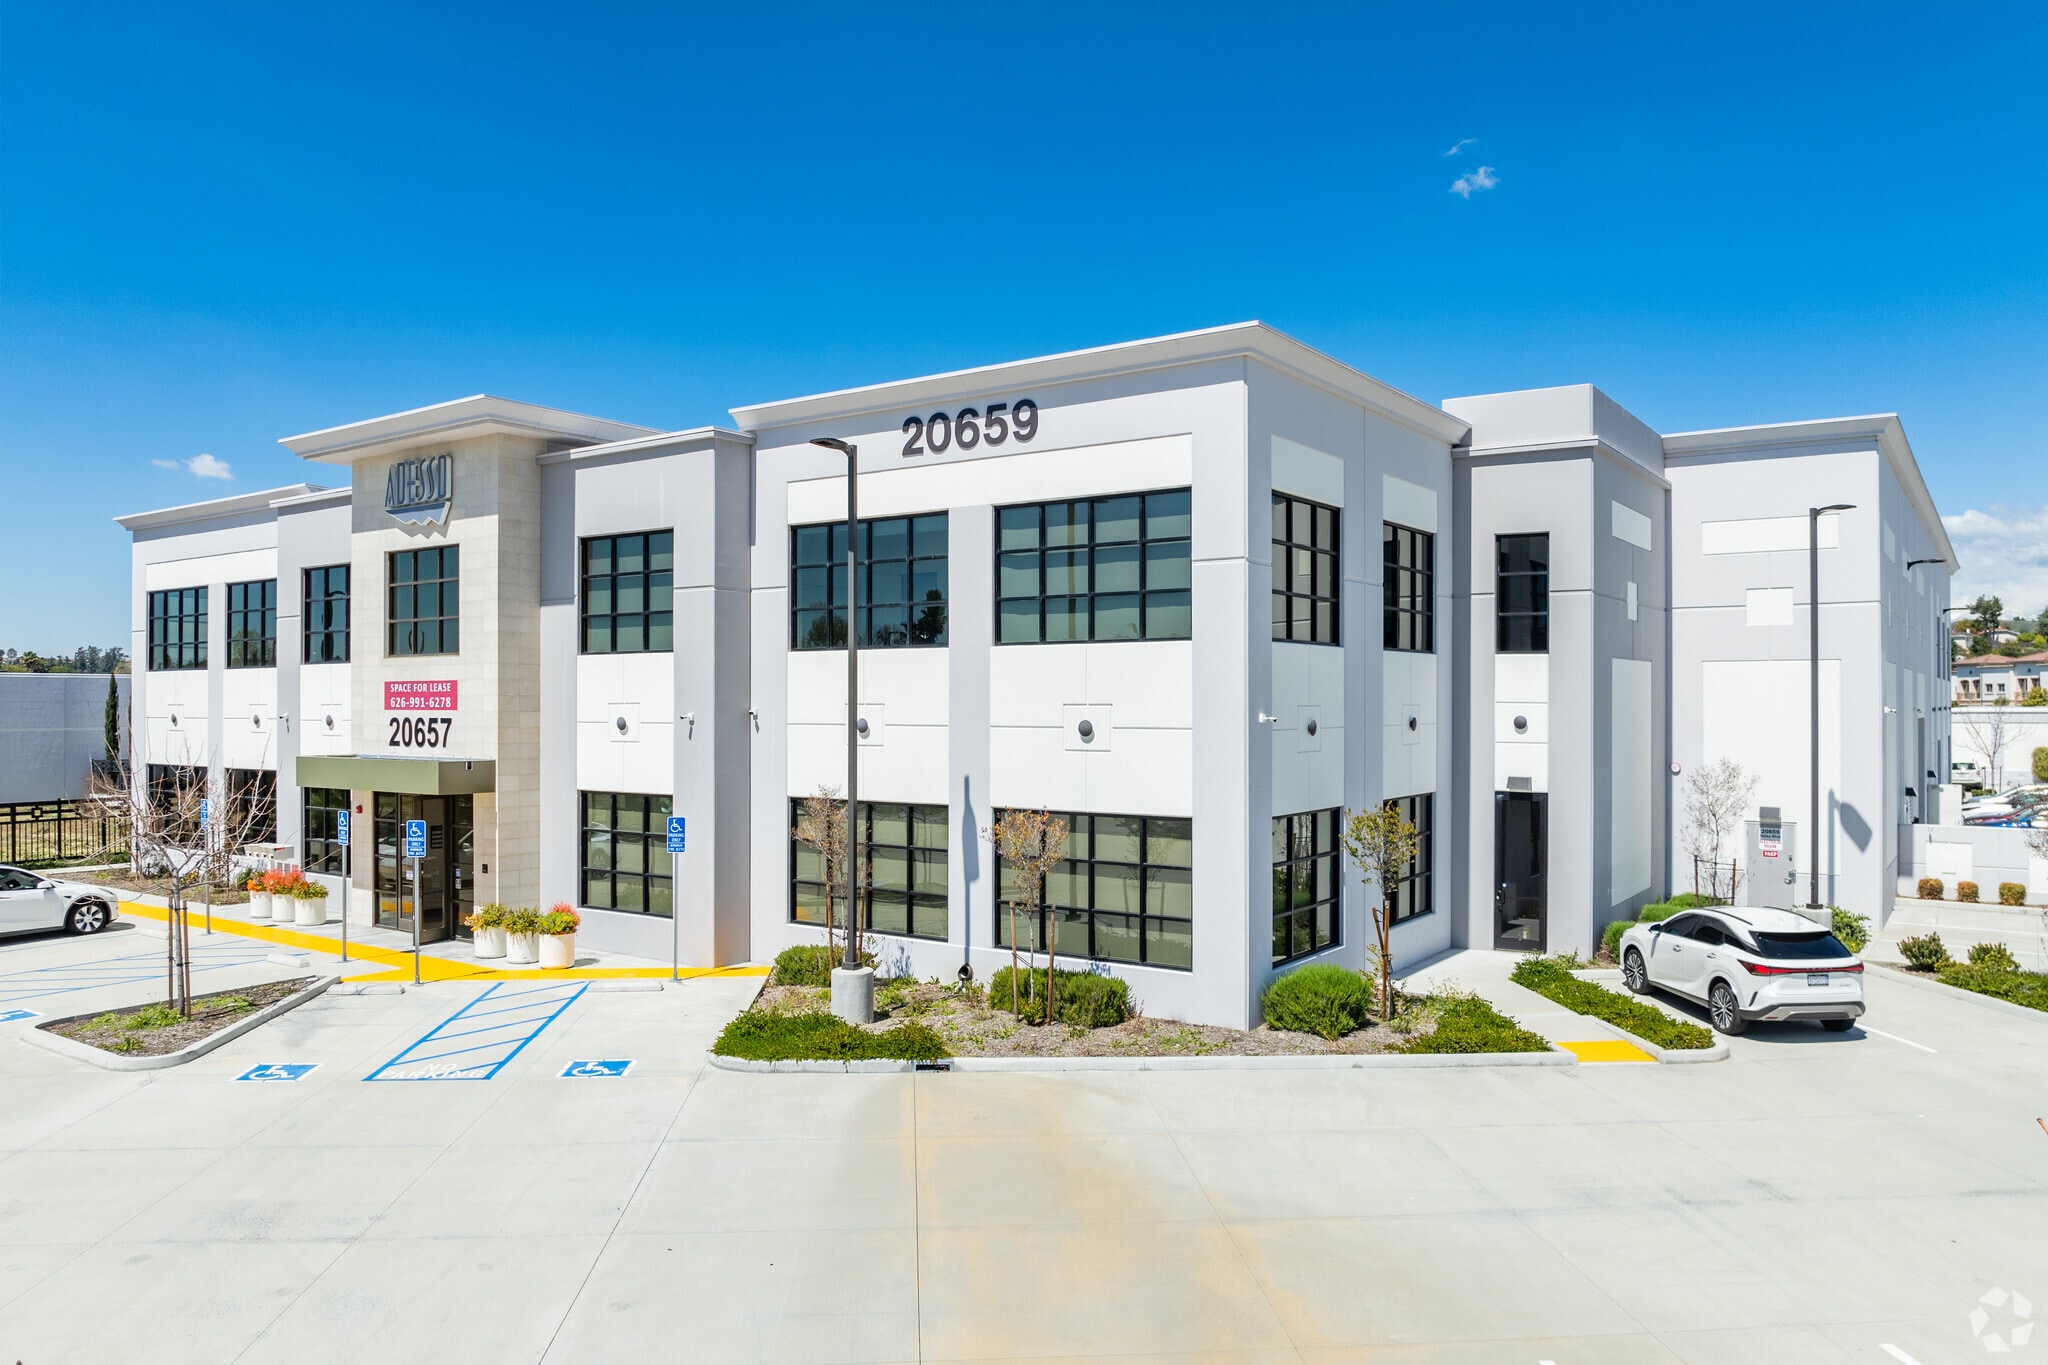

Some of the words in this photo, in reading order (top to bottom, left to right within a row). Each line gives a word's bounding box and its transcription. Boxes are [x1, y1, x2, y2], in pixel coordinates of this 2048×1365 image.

[902, 399, 1038, 457] 20659
[384, 455, 448, 507] ADESSO
[390, 683, 411, 693] SPACE
[413, 683, 428, 693] FOR
[429, 682, 452, 692] LEASE
[390, 696, 451, 708] 626-991-6278
[388, 716, 452, 748] 20657
[420, 1063, 459, 1072] NO
[376, 1070, 486, 1080] PARKING
